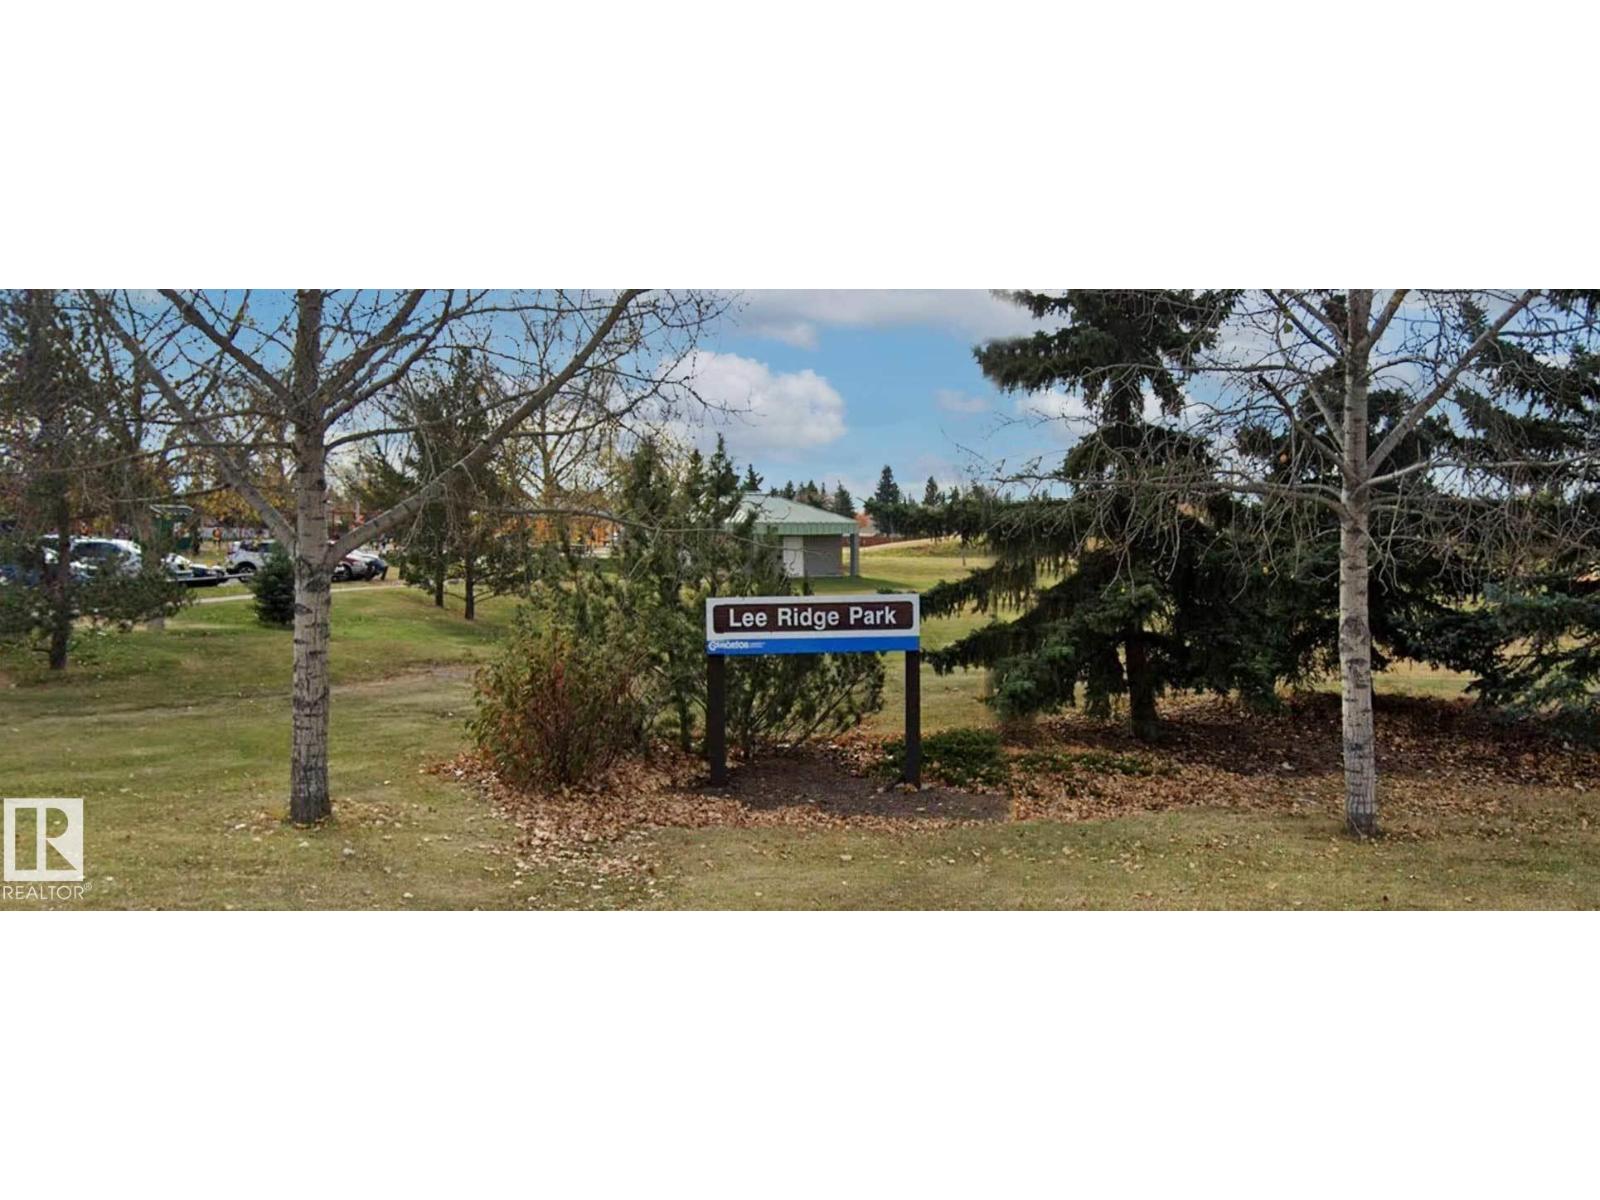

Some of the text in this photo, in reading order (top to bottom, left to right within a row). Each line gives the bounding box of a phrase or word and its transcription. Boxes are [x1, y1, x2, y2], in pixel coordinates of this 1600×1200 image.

[728, 606, 897, 630] Lee Ridge Park
